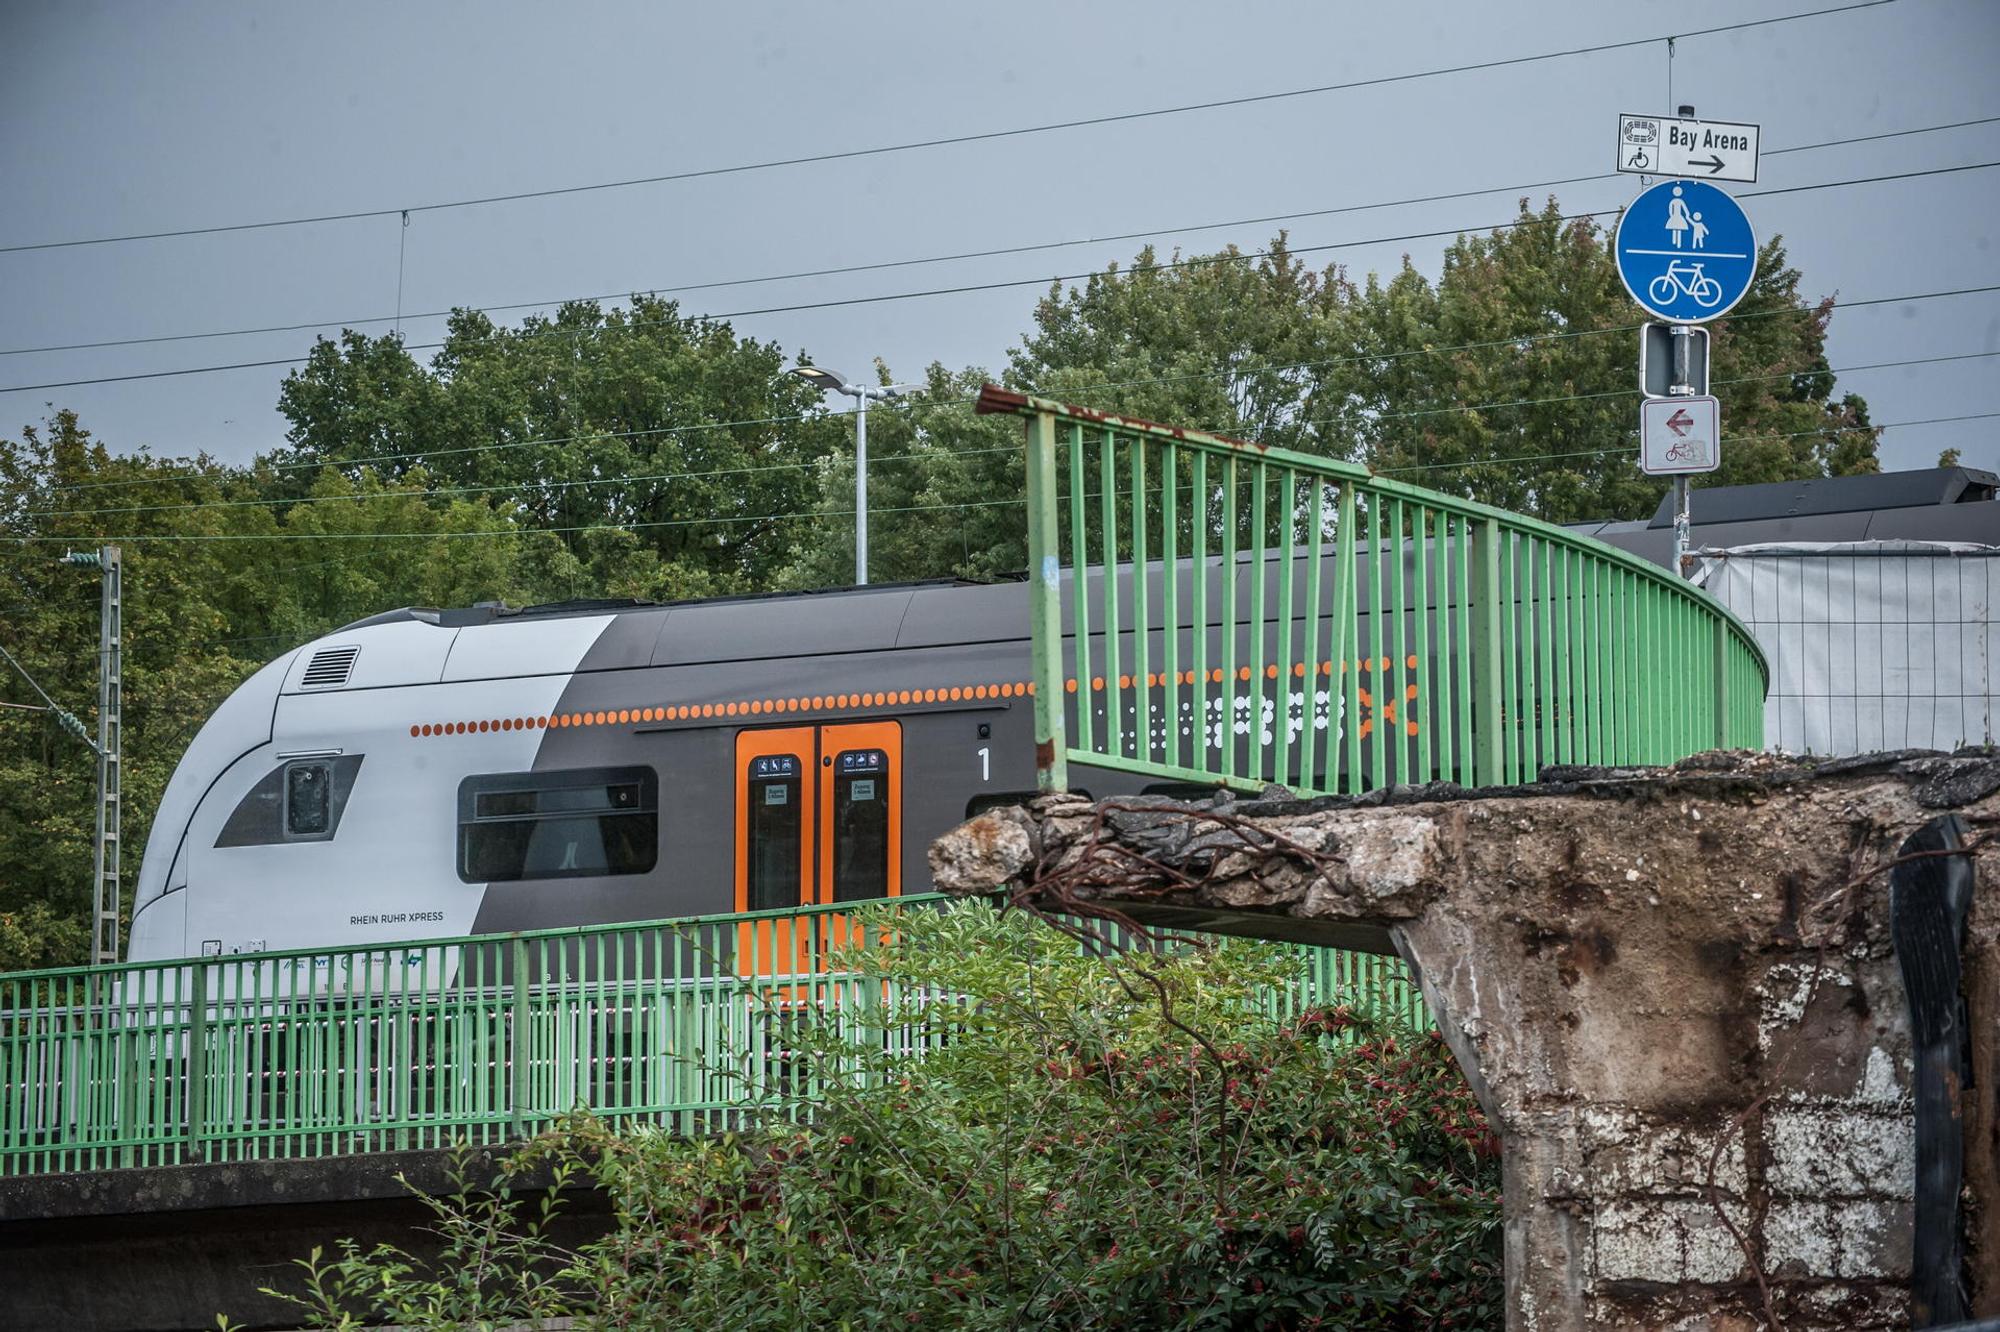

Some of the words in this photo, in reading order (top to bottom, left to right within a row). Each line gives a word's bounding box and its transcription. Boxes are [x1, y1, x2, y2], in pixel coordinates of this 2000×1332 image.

[1669, 125, 1697, 152] Bay
[1703, 128, 1748, 151] Arena
[978, 747, 989, 781] 1
[350, 915, 378, 925] RHEIN
[381, 913, 407, 924] RUHR
[408, 911, 444, 922] XPRESS
